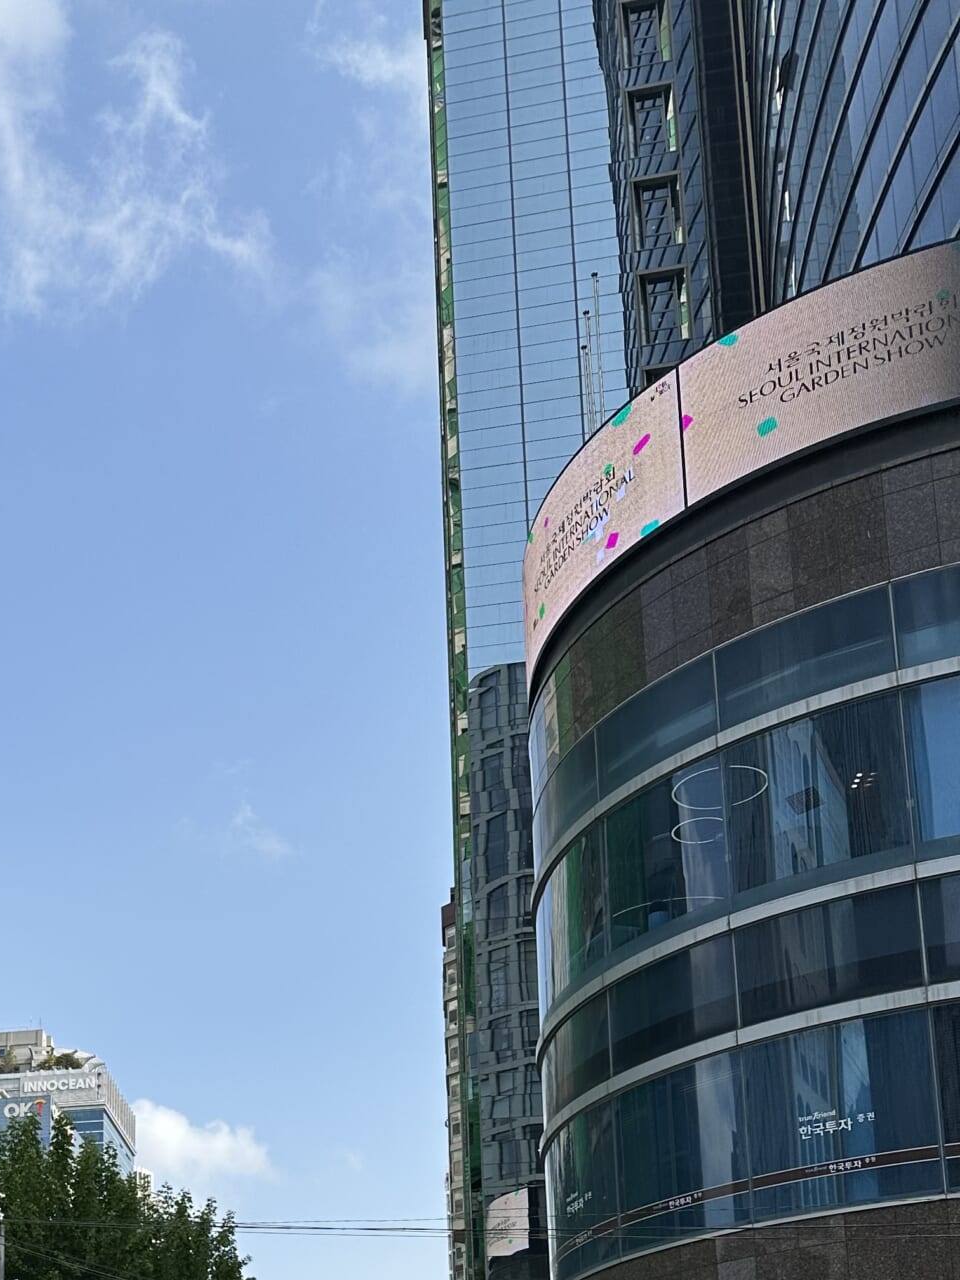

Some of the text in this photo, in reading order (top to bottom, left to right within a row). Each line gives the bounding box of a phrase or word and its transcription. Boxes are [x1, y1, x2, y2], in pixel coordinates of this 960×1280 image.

[738, 368, 804, 409] SEOUL
[779, 332, 948, 403] GARDEN SHOW
[552, 469, 636, 561] INTERNATIONAL
[544, 504, 611, 590] GARDEN SHOW
[23, 1076, 97, 1093] INNOCEAN
[799, 1112, 875, 1139] 한국투자 증권
